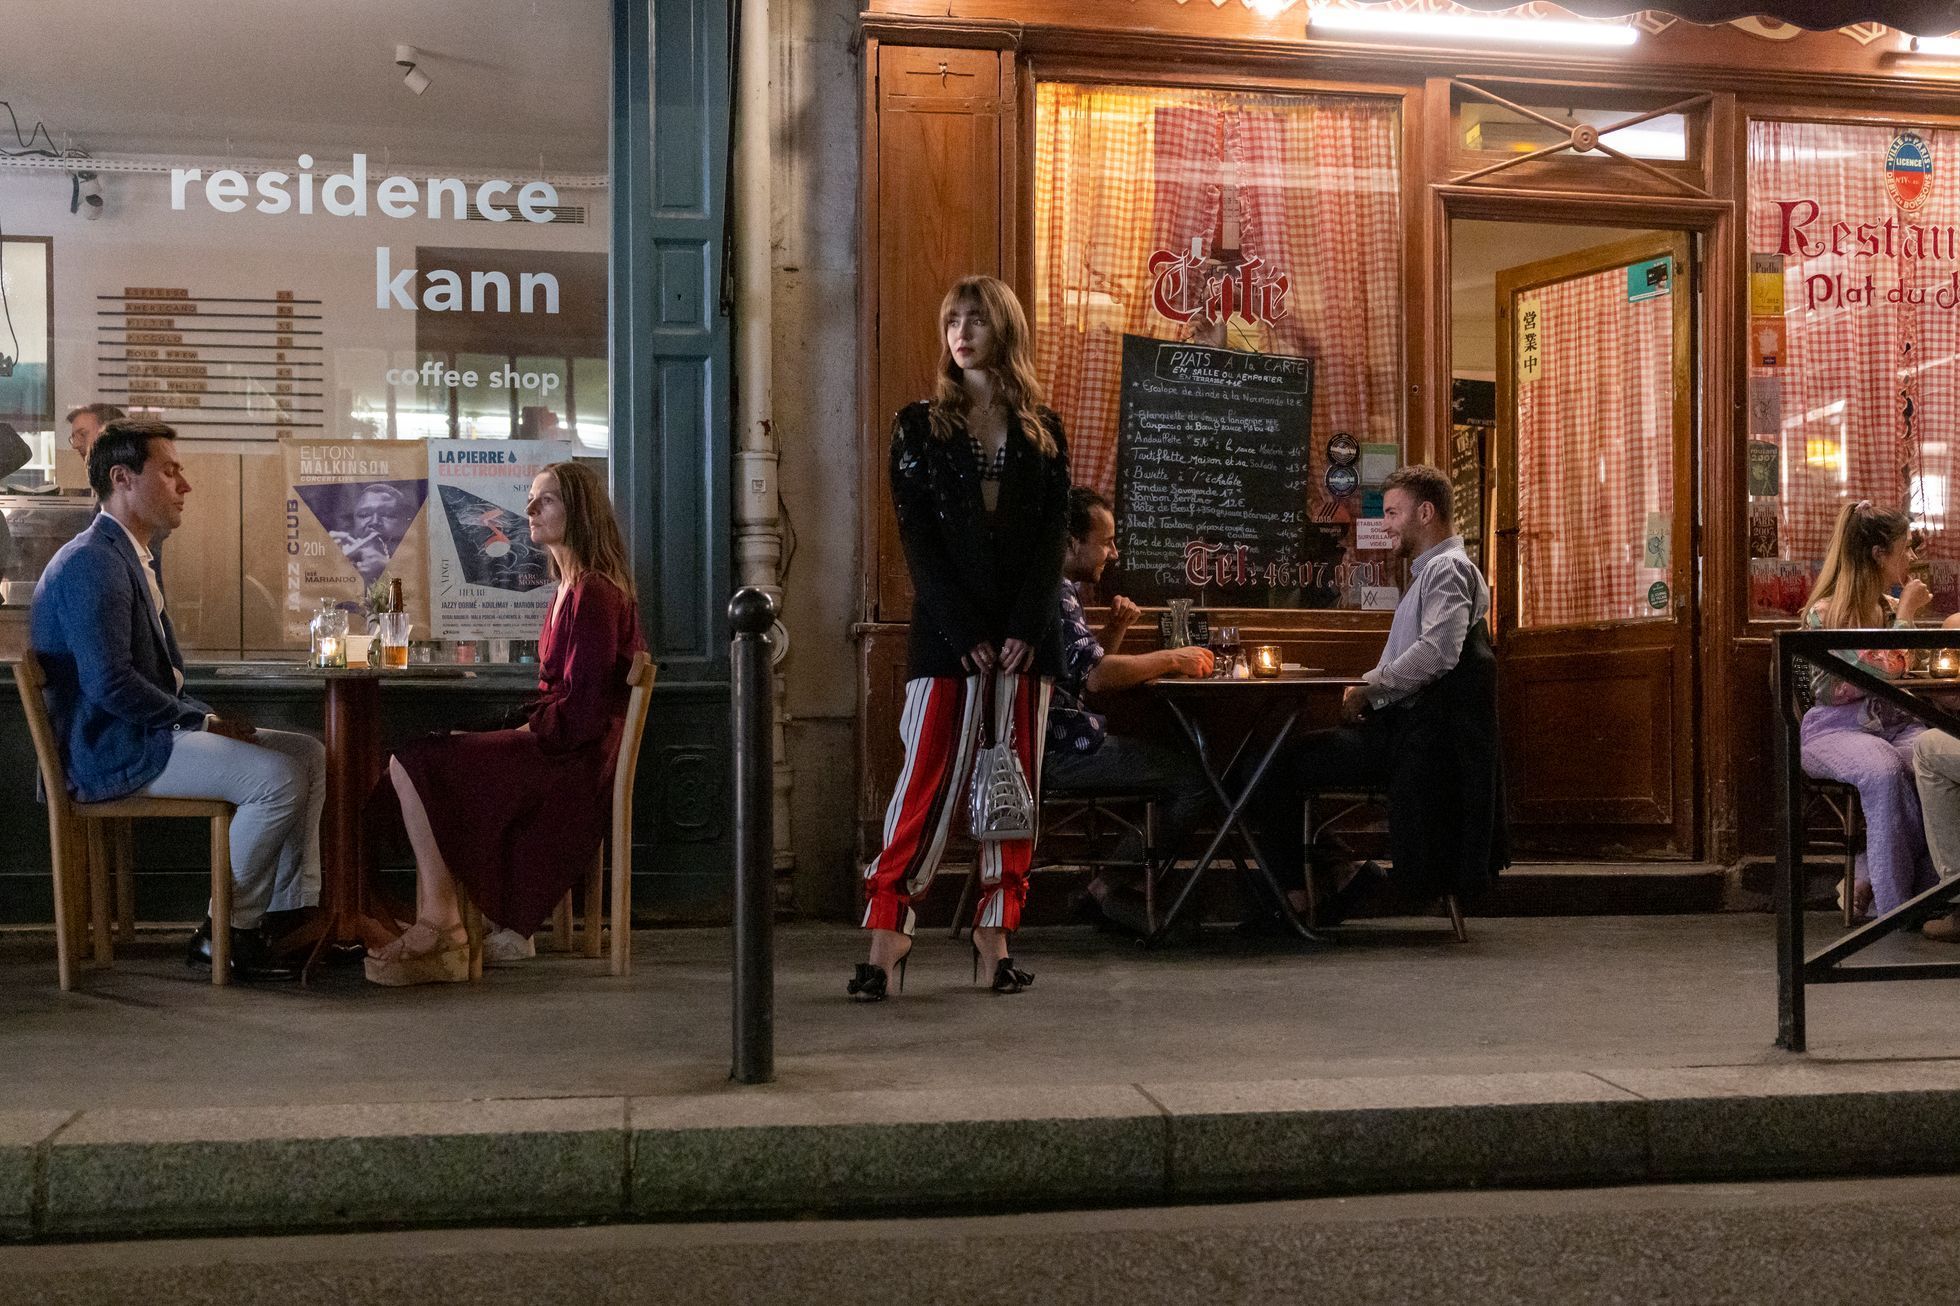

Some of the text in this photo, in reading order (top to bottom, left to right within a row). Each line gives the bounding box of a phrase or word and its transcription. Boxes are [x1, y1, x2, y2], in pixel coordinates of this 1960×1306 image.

[1887, 138, 1904, 162] VILLE
[1912, 138, 1931, 164] PARIS
[1896, 157, 1922, 167] LICENCE
[171, 154, 559, 223] residence
[1903, 174, 1932, 209] BOISSONS
[1770, 199, 1955, 260] Restau
[376, 246, 560, 314] kann
[1148, 248, 1290, 328] Café
[1803, 272, 1877, 311] Plat
[1886, 278, 1927, 304] du
[126, 304, 196, 312] AMERICANO
[1523, 311, 1538, 374] 営業中
[1170, 351, 1211, 367] PLATS
[1245, 358, 1255, 370] la
[1264, 359, 1305, 375] CARTE
[386, 361, 560, 395] coffee shop
[1172, 366, 1188, 374] EN
[1192, 367, 1219, 378] SALLE
[1242, 373, 1284, 384] EMPORTER
[1182, 385, 1193, 396] de
[1231, 390, 1240, 401] la
[1185, 422, 1194, 431] de
[300, 445, 355, 460] ELTON
[438, 450, 455, 464] LA
[457, 450, 505, 464] PIERRE
[300, 460, 389, 474] MALKINSON
[1132, 482, 1168, 493] Fondue
[1158, 503, 1169, 513] de
[287, 499, 299, 556] CLUB
[303, 541, 326, 557] 20h
[287, 563, 300, 612] JAZZ
[441, 601, 457, 609] JAZZY
[513, 601, 535, 609] MARION
[535, 601, 549, 609] DUSE
